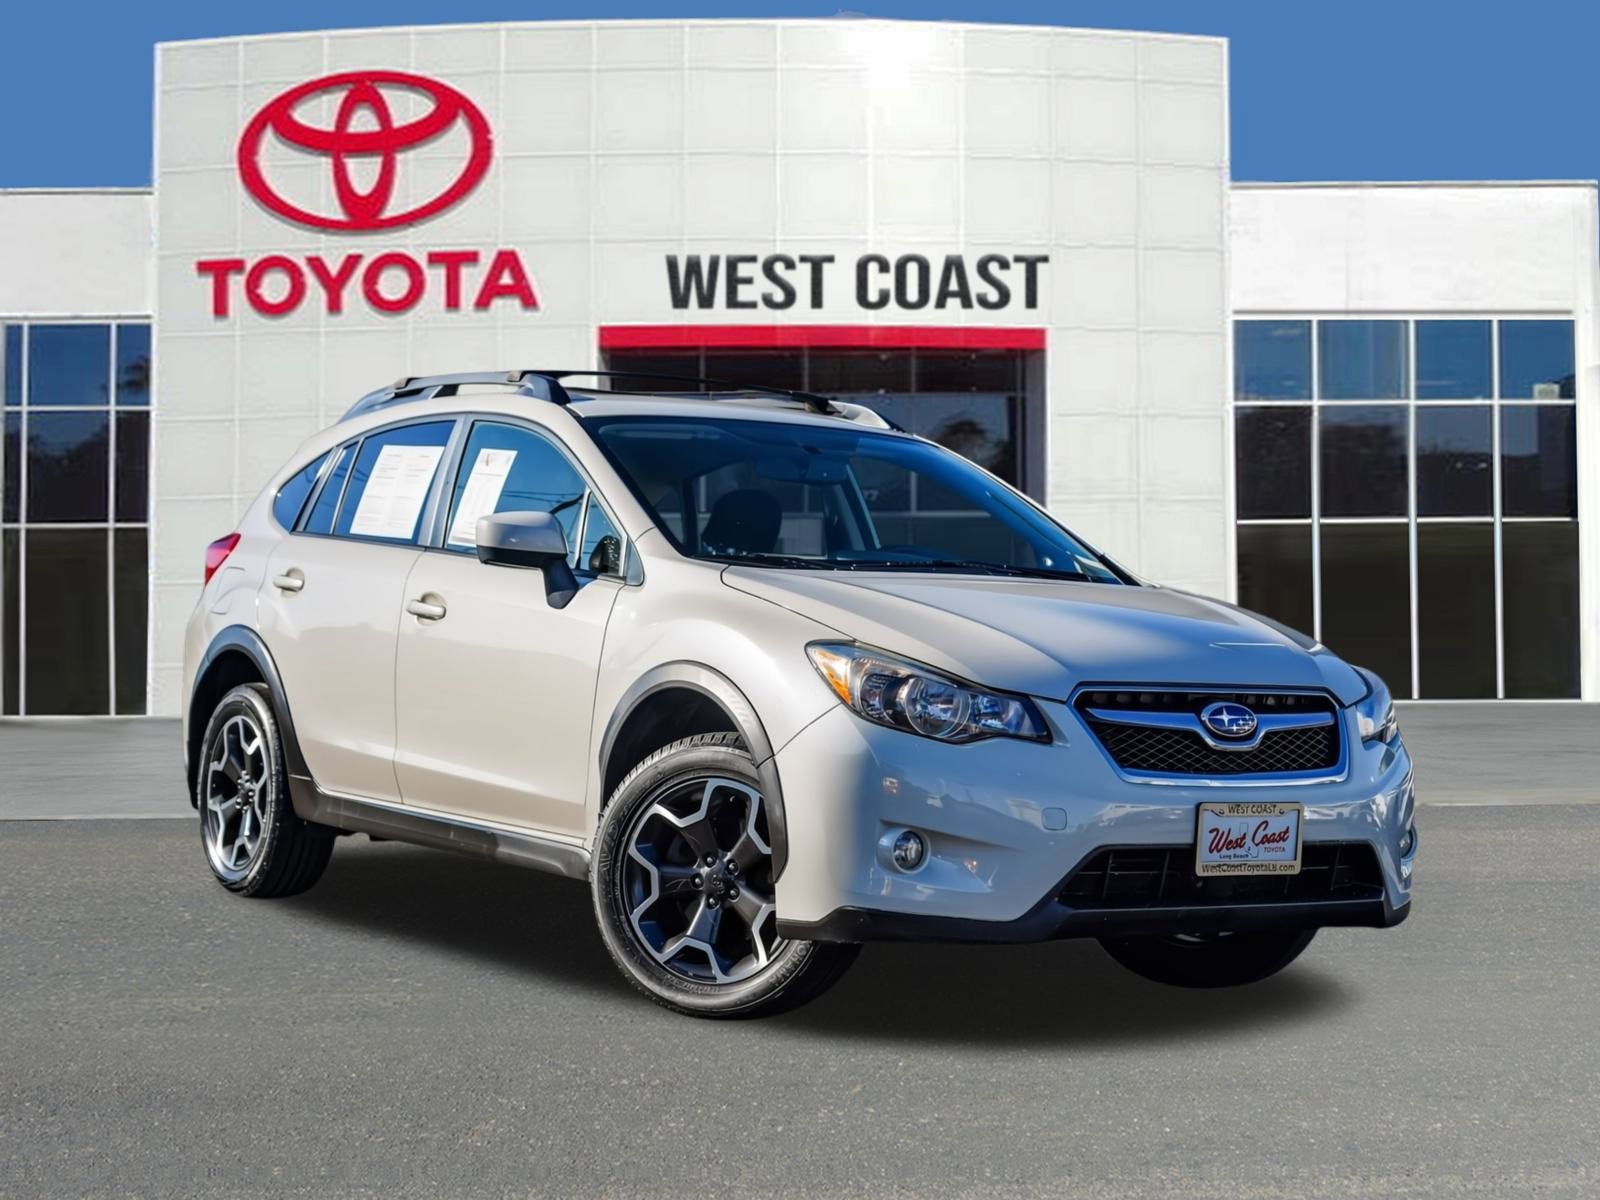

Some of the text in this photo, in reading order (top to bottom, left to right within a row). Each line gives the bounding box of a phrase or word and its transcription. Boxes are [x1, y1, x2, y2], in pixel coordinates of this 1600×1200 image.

[197, 250, 538, 317] TOYOTA
[666, 253, 1050, 311] WEST COAST
[1228, 804, 1277, 815] WEST COAST
[1208, 820, 1290, 854] West Coast
[1201, 862, 1296, 874] WestCoastToyotaLB.com
